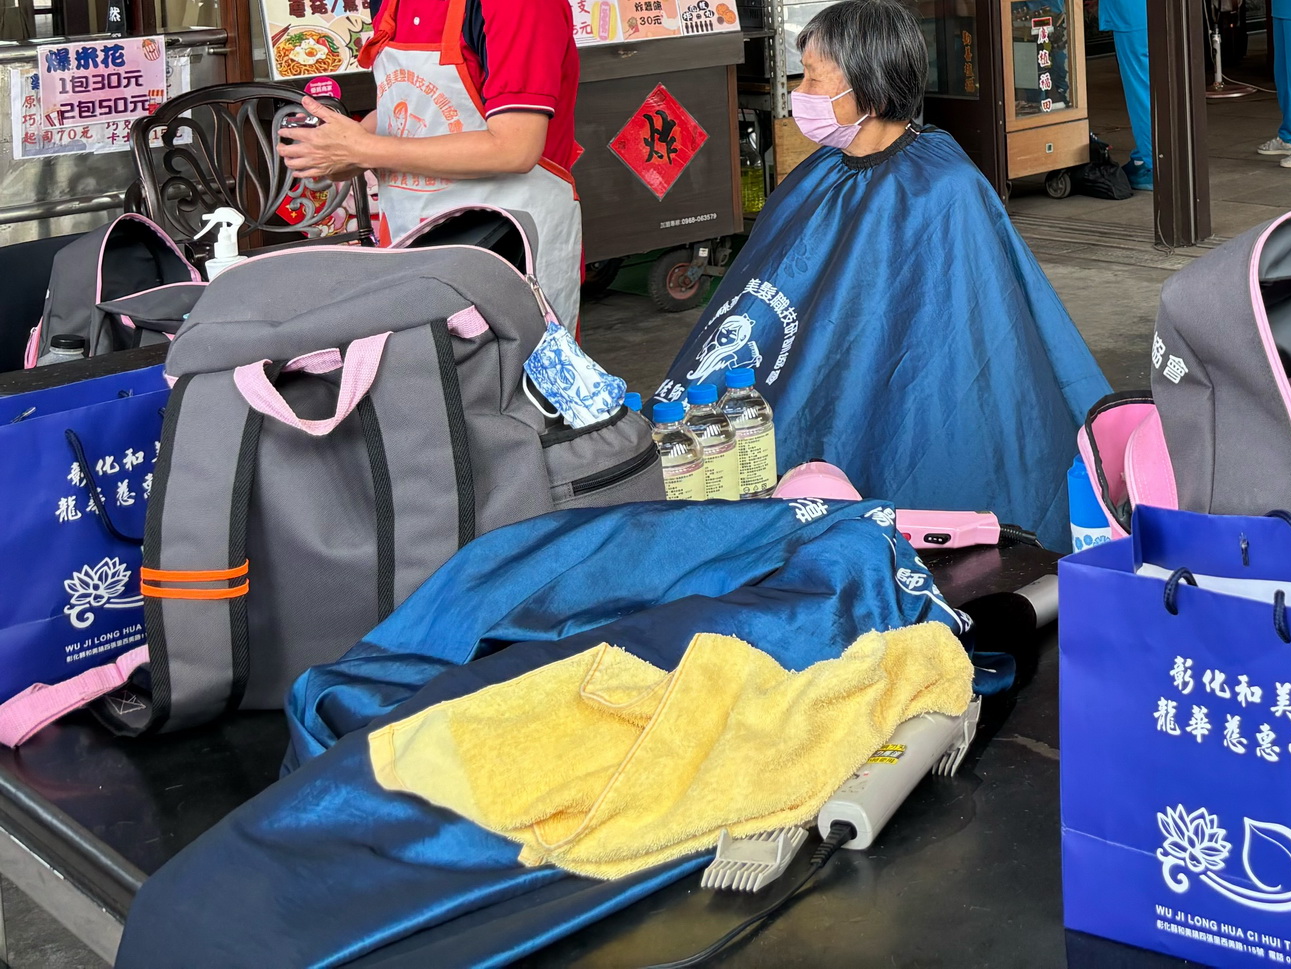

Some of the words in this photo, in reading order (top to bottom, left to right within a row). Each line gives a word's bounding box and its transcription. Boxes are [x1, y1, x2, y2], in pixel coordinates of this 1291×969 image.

[639, 16, 663, 26] 30元
[45, 44, 126, 73] 爆米花
[1037, 26, 1052, 112] 廣植福田
[59, 69, 144, 94] 1包30元
[60, 94, 149, 120] 2包50元
[65, 642, 82, 654] WU
[85, 638, 93, 650] JI
[95, 631, 121, 647] LONG
[122, 623, 143, 638] HUA
[1156, 904, 1173, 917] WU
[1175, 911, 1185, 921] JI
[1187, 914, 1218, 931] LONG
[1221, 923, 1244, 939] HUA
[1247, 931, 1259, 942] CI
[1262, 935, 1281, 948] HUI
